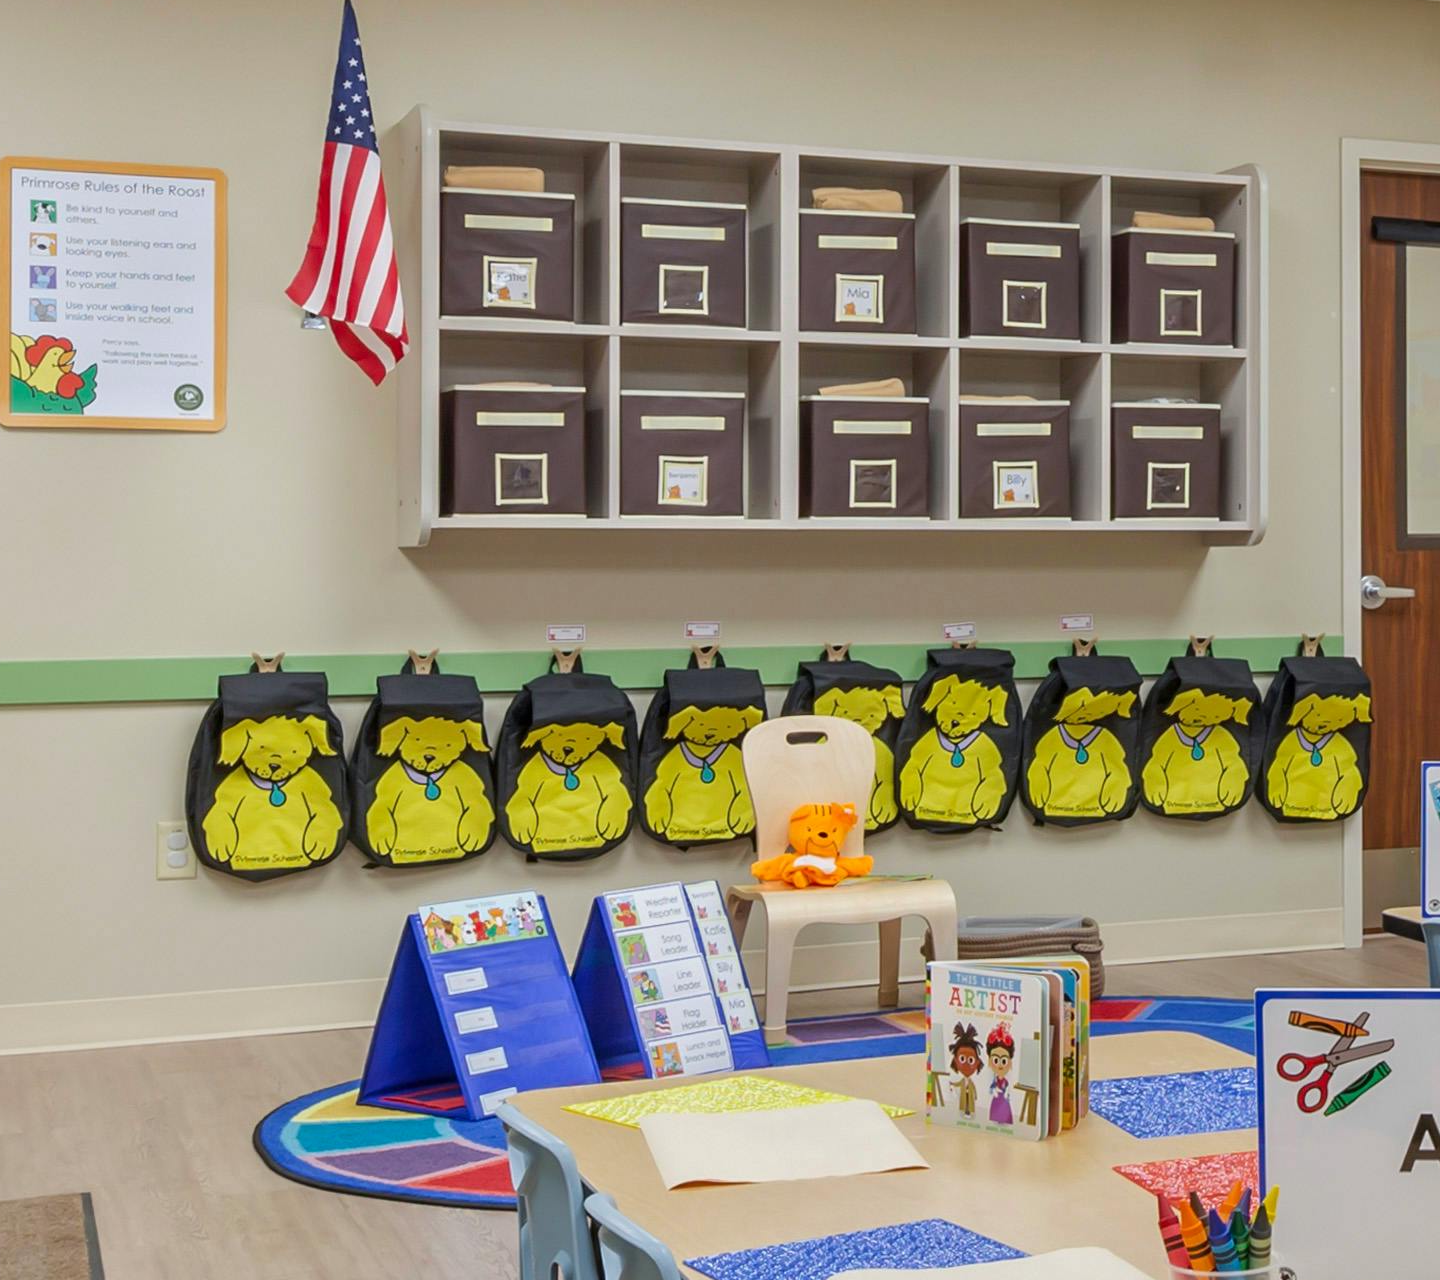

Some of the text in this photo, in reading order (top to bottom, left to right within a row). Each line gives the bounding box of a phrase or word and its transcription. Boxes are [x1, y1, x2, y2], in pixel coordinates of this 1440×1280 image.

[21, 176, 205, 198] Primrose Rules of the Roost
[65, 203, 178, 218] Be kind to yourself and
[65, 236, 197, 251] Use your listening ears and
[65, 247, 102, 258] looking
[65, 269, 196, 283] Keep your hands and feet
[65, 280, 76, 288] to
[847, 287, 870, 300] Mia
[65, 301, 193, 314] Use your walking feet and
[64, 312, 94, 321] inside
[96, 313, 124, 323] voice
[126, 314, 136, 323] in
[1007, 473, 1027, 487] Billy
[234, 854, 271, 865] Primrose
[645, 895, 678, 907] Weather
[648, 906, 682, 919] Reporter
[703, 924, 727, 936] Katie
[661, 934, 682, 945] Song
[660, 945, 688, 955] Leader
[676, 970, 693, 980] Line
[673, 981, 701, 992] Leader
[956, 973, 1015, 990] THIS LITTLE
[728, 998, 746, 1009] Mia
[948, 986, 1022, 1015] ARTIST
[683, 1008, 700, 1019] Flag
[682, 1019, 707, 1029] Holder
[686, 1038, 721, 1052] Lunch and
[706, 1049, 727, 1061] Helper
